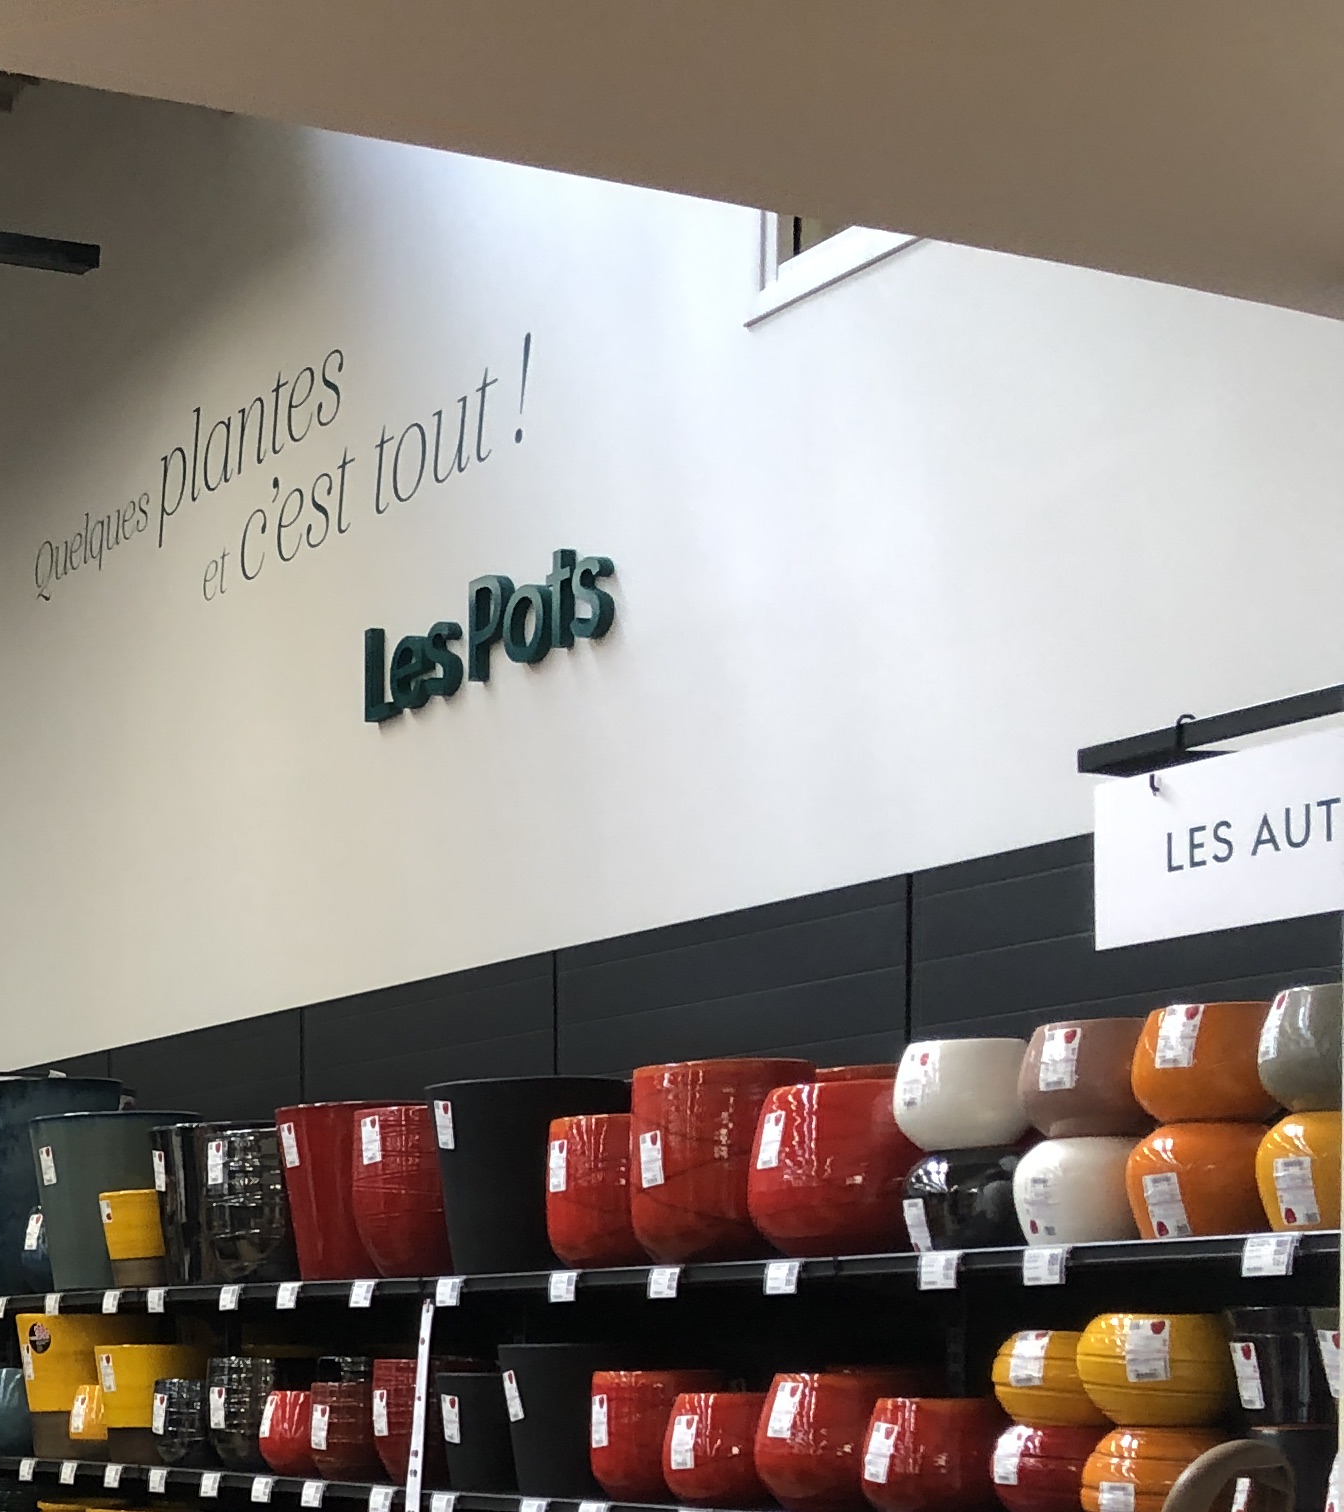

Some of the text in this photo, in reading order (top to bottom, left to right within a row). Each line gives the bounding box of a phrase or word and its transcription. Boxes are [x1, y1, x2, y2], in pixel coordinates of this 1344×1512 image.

[34, 348, 345, 601] Quelques plantes
[202, 545, 230, 602] et
[240, 446, 356, 582] c'est
[374, 367, 498, 515] tout
[365, 548, 615, 722] Les Pots
[1166, 820, 1234, 873] LES
